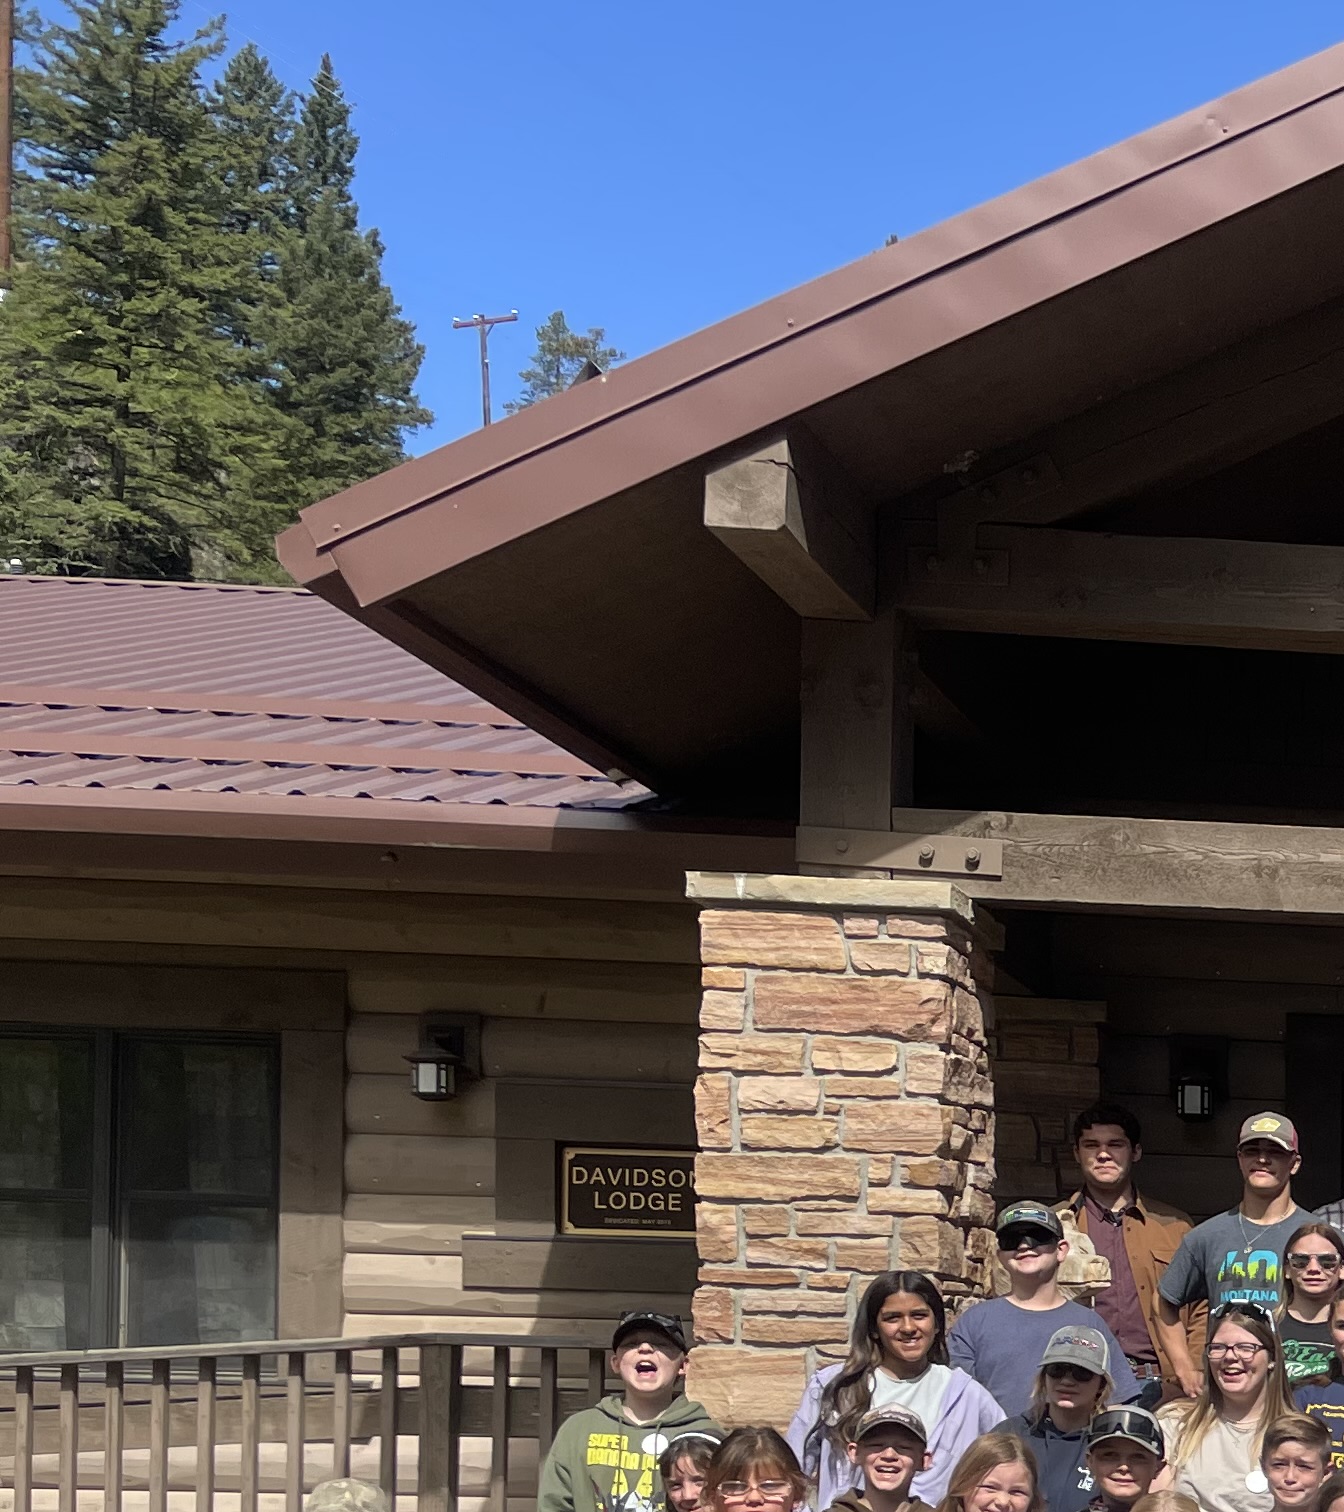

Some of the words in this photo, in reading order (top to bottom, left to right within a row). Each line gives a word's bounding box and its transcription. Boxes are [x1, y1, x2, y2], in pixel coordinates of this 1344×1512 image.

[594, 1191, 682, 1211] LODGE
[1217, 1250, 1281, 1287] 40
[1220, 1290, 1279, 1302] MONTANA
[587, 1433, 629, 1451] SUPER
